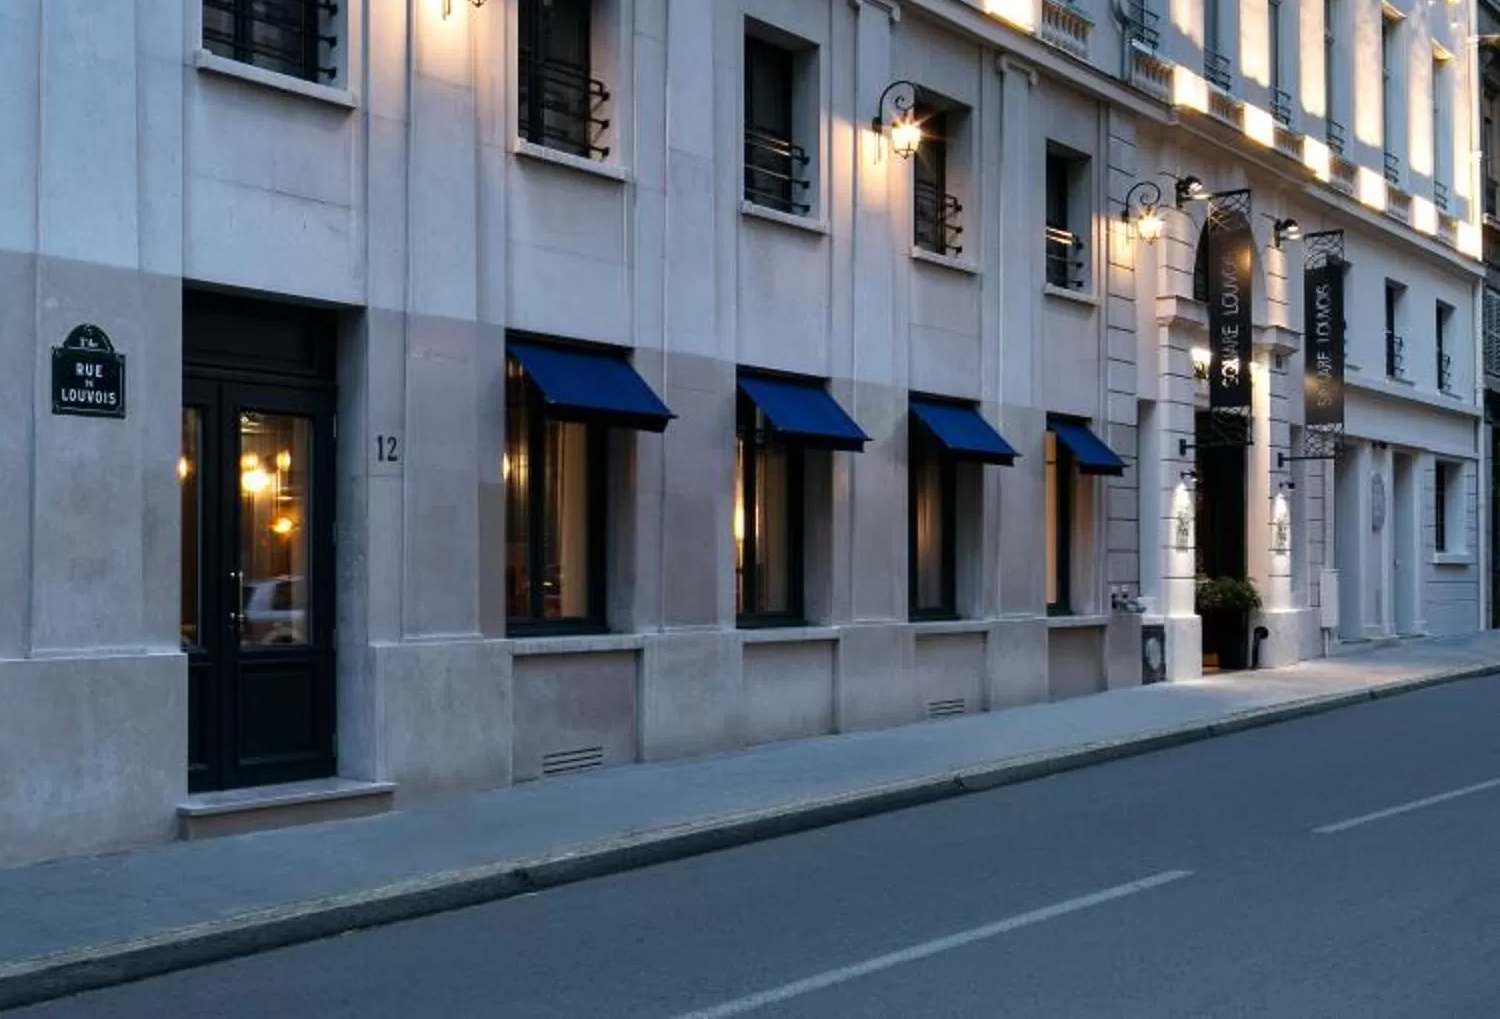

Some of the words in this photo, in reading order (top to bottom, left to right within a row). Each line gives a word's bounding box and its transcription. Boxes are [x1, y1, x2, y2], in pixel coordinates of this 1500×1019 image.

[1220, 252, 1239, 316] LOUVOI
[1220, 324, 1239, 389] SQUARE
[75, 363, 104, 378] RUE
[61, 388, 117, 406] LOUVOIS
[377, 435, 398, 462] 12
